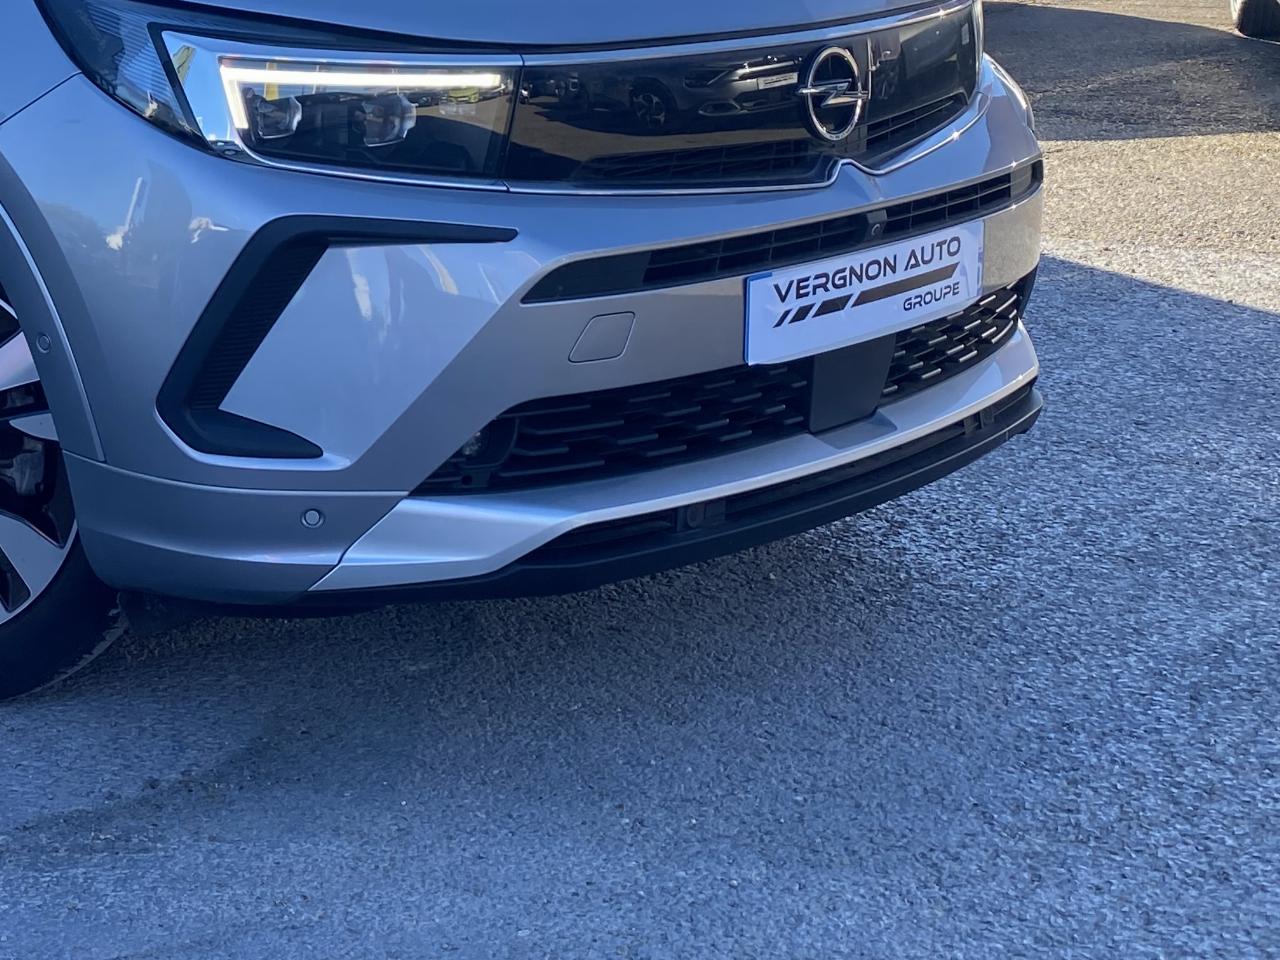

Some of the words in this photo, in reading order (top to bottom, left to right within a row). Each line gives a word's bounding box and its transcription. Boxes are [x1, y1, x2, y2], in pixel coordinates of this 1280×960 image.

[773, 254, 897, 303] VERGNON
[904, 236, 961, 271] AUTO
[903, 281, 960, 312] GROUPE
